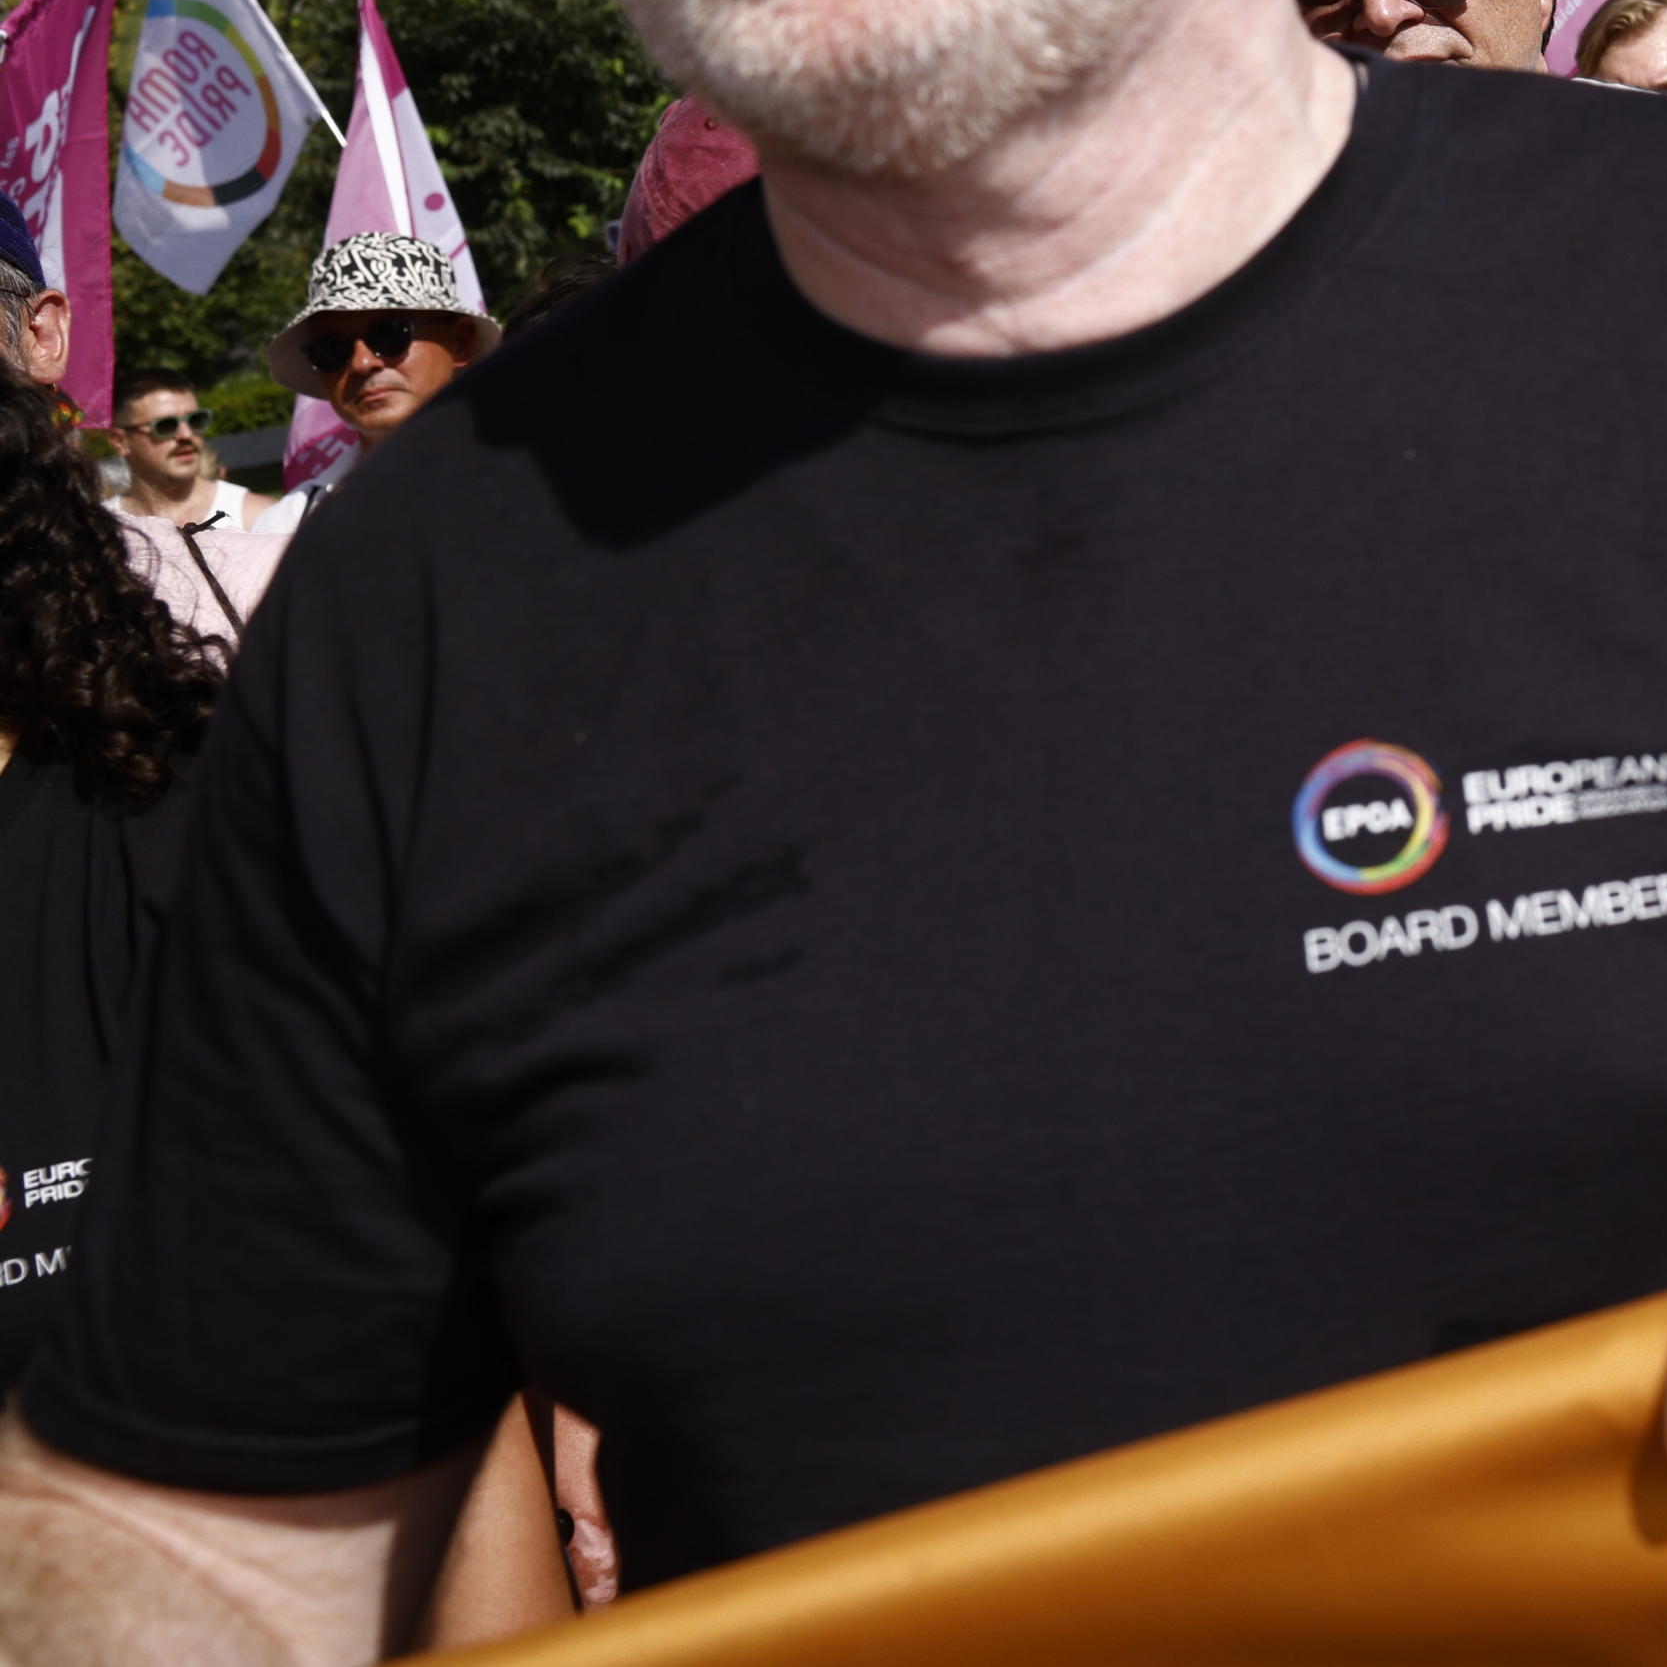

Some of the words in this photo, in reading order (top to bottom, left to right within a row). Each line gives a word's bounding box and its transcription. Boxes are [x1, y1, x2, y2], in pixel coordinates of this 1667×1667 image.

[1321, 796, 1414, 842] EPOA
[1466, 792, 1577, 835] PRIDE
[1303, 903, 1480, 975] BOARD
[24, 1179, 89, 1209] PRID
